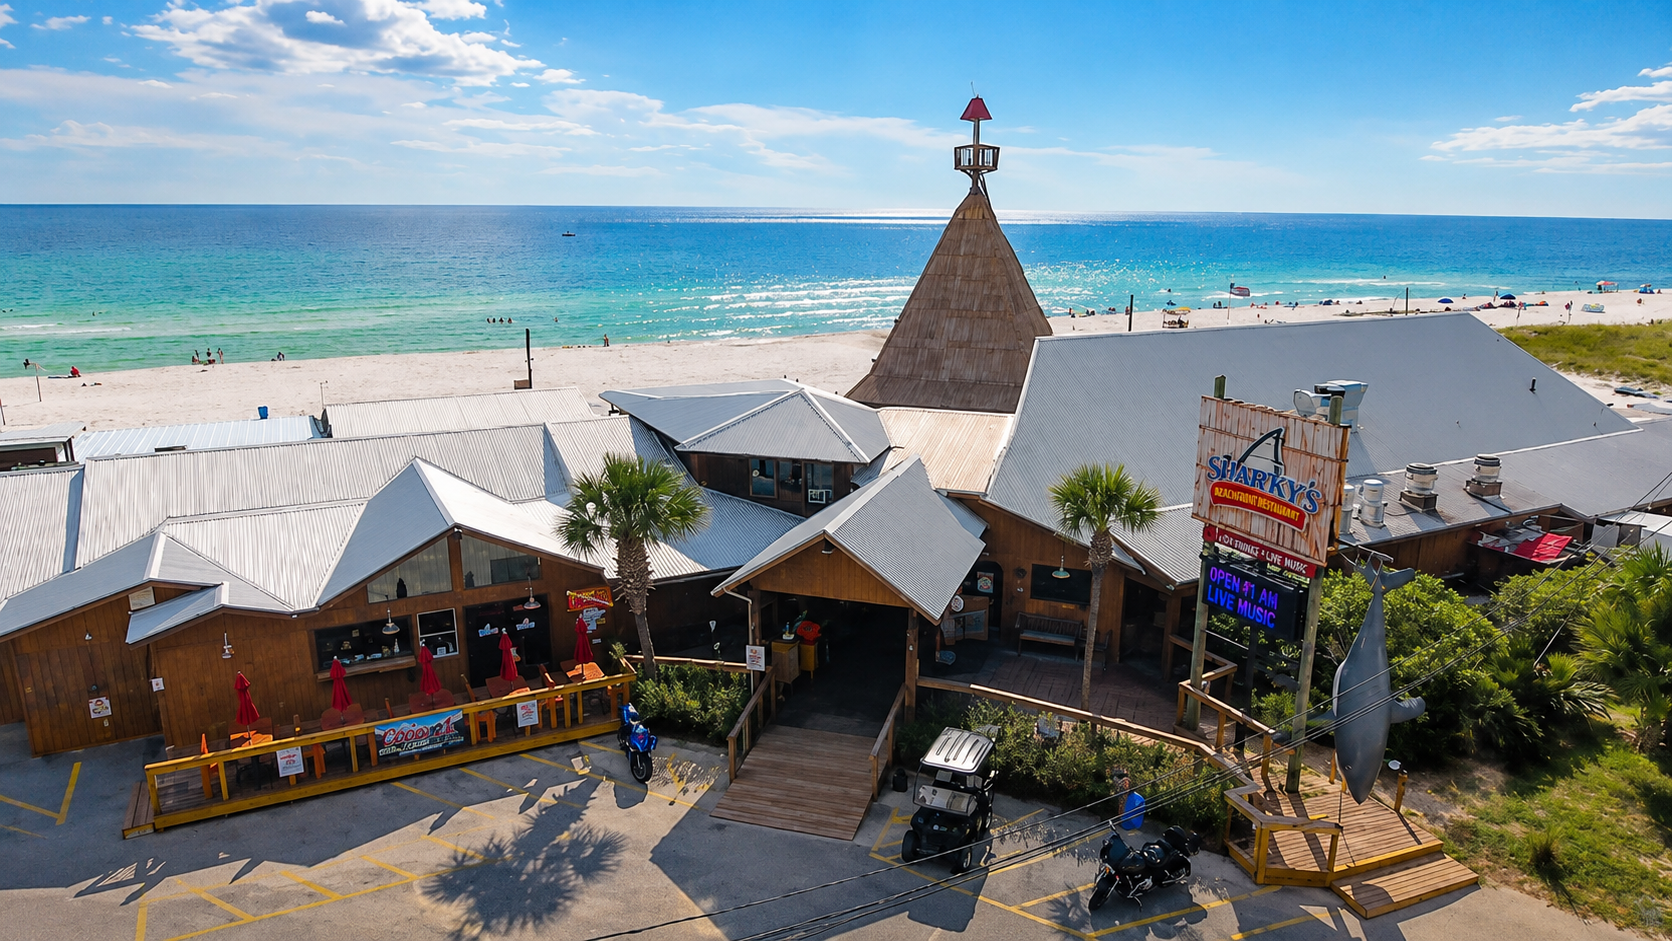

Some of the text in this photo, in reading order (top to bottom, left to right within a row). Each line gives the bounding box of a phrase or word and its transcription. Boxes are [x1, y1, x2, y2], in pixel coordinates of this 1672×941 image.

[1207, 455, 1322, 514] SHARKY'S
[1207, 584, 1276, 629] LIVE MUSIC
[1210, 566, 1240, 593] OPEN
[1259, 588, 1278, 610] AM
